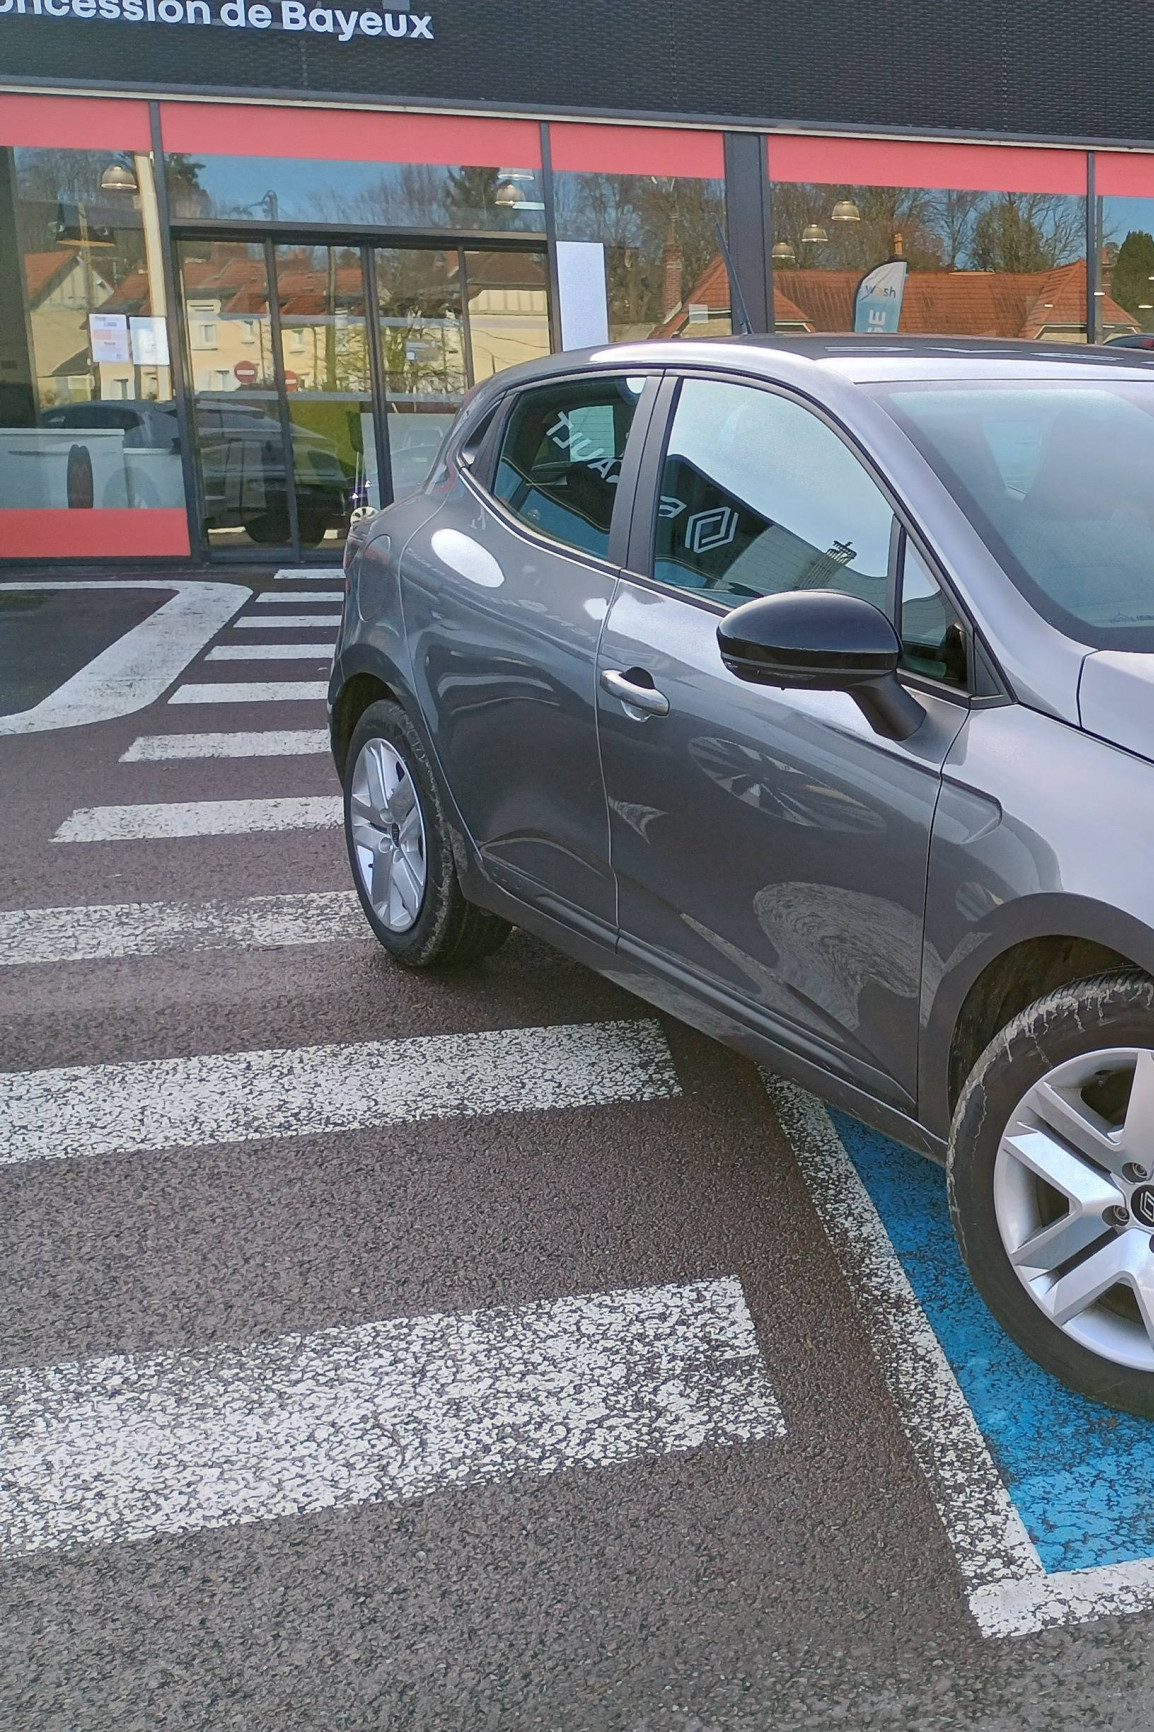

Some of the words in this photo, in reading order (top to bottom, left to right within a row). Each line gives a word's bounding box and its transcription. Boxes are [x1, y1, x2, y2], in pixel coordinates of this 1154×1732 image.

[0, 0, 211, 25] ncession
[220, 0, 272, 28] de
[281, 1, 434, 42] Bayeux
